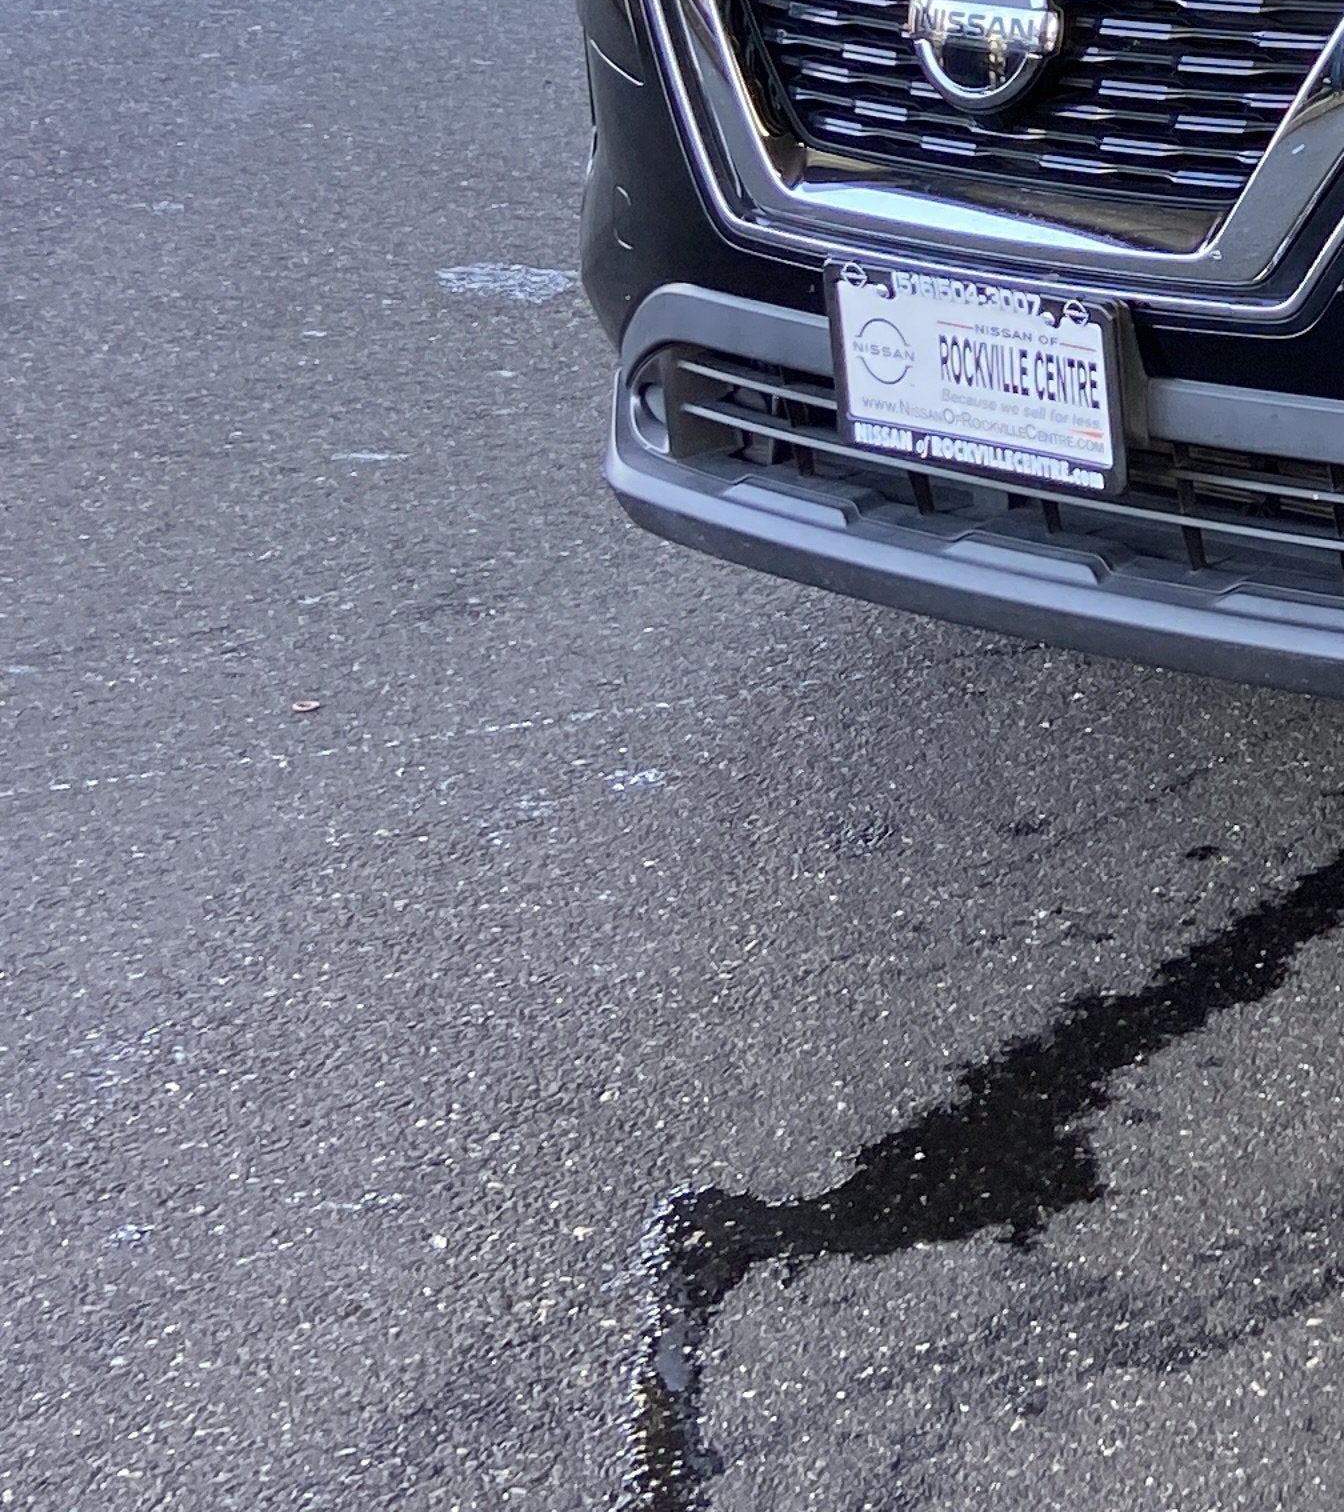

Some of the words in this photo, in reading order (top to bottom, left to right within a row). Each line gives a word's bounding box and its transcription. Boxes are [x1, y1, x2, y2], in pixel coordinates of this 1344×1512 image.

[914, 3, 1034, 40] NISSAN
[853, 340, 916, 362] NISSAN
[974, 323, 1033, 343] NISSAN
[1038, 334, 1059, 347] OF
[939, 333, 1030, 397] ROCKVILLE
[1034, 349, 1101, 410] CENTRE
[942, 388, 997, 411] Because
[1001, 401, 1020, 416] we
[1024, 406, 1047, 420] sell
[1050, 408, 1070, 424] for
[854, 421, 913, 452] NISSAN
[915, 434, 932, 459] of
